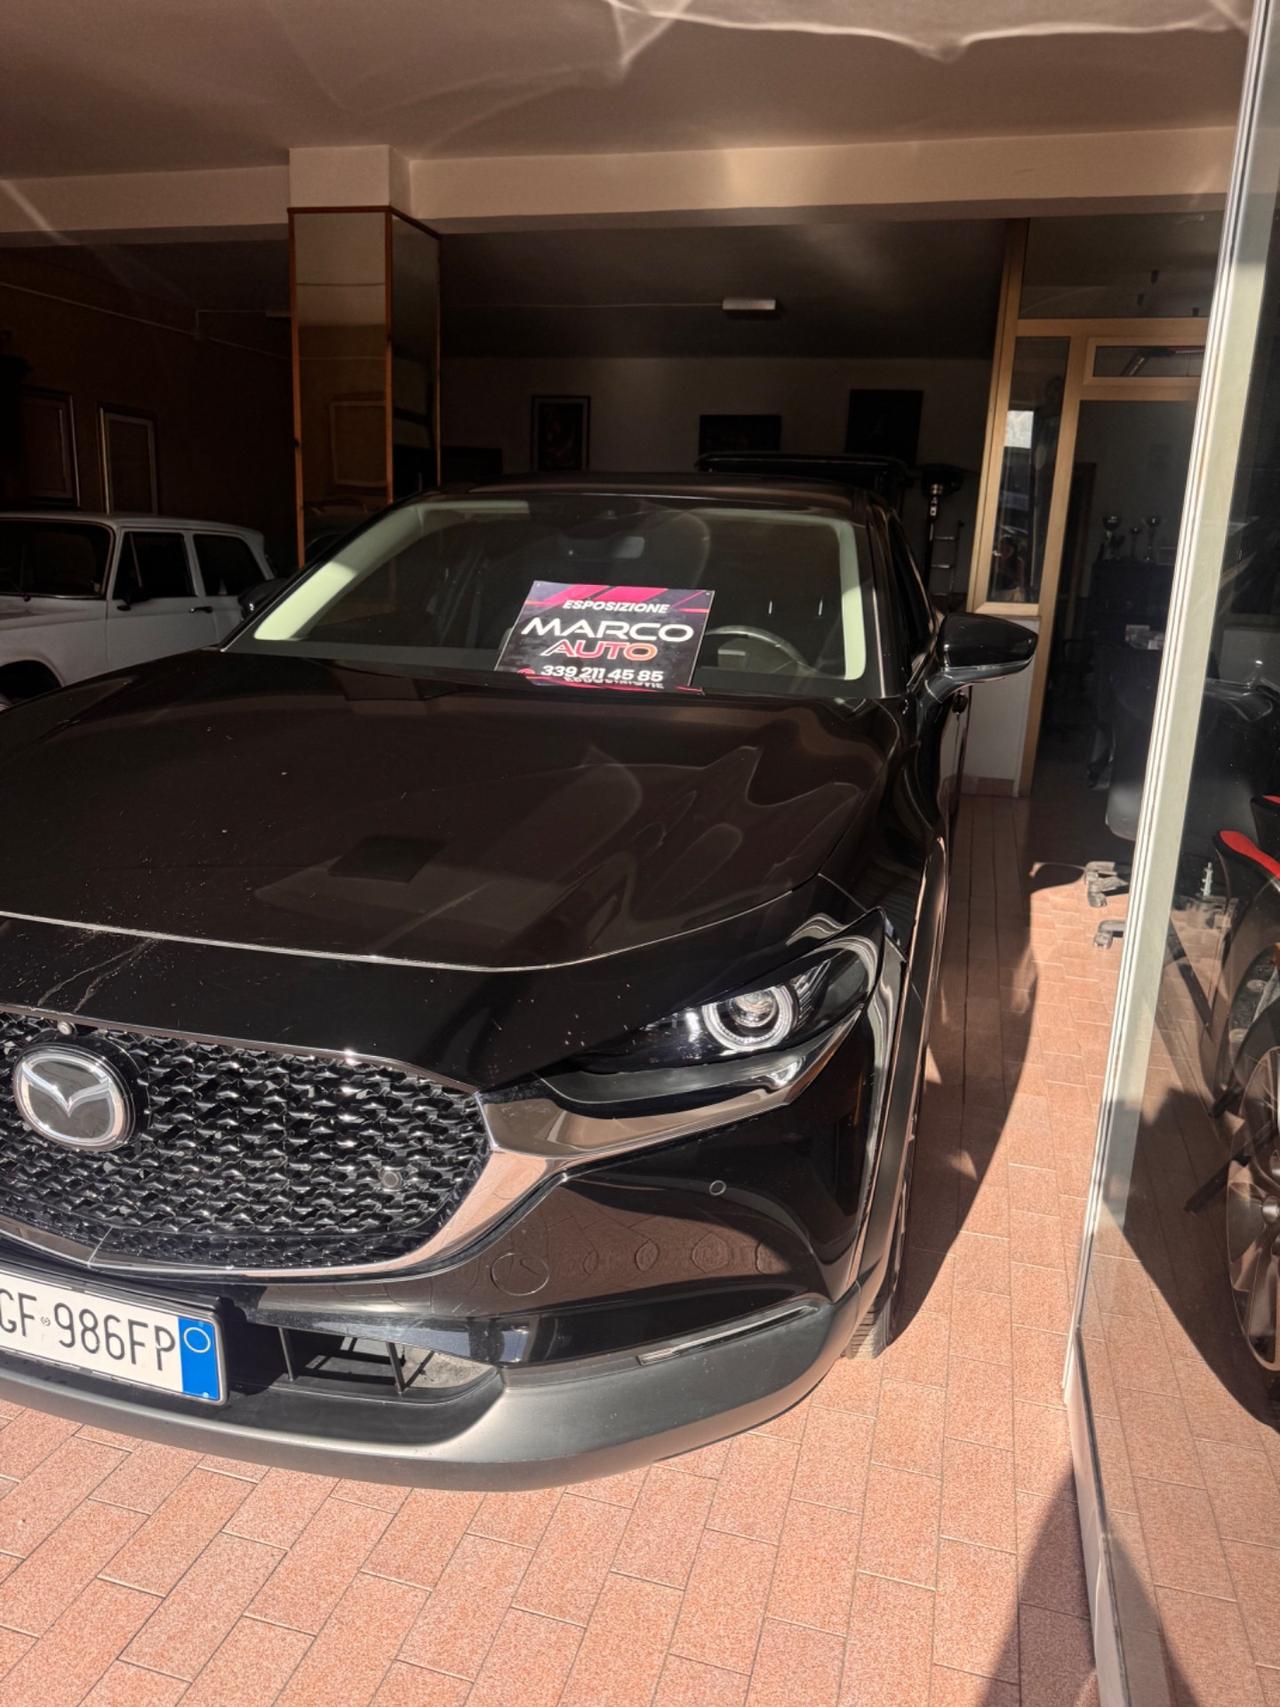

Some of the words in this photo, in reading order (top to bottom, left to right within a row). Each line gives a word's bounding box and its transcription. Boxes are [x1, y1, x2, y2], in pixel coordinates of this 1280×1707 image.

[562, 599, 671, 614] ESPOSIZIONE
[520, 616, 695, 643] MARCO
[540, 638, 658, 661] AUTO
[540, 664, 579, 678] 339
[580, 666, 606, 680] 211
[607, 668, 635, 681] 45
[636, 670, 664, 683] 85
[0, 1288, 37, 1337] GF
[53, 1302, 176, 1371] 986FP
